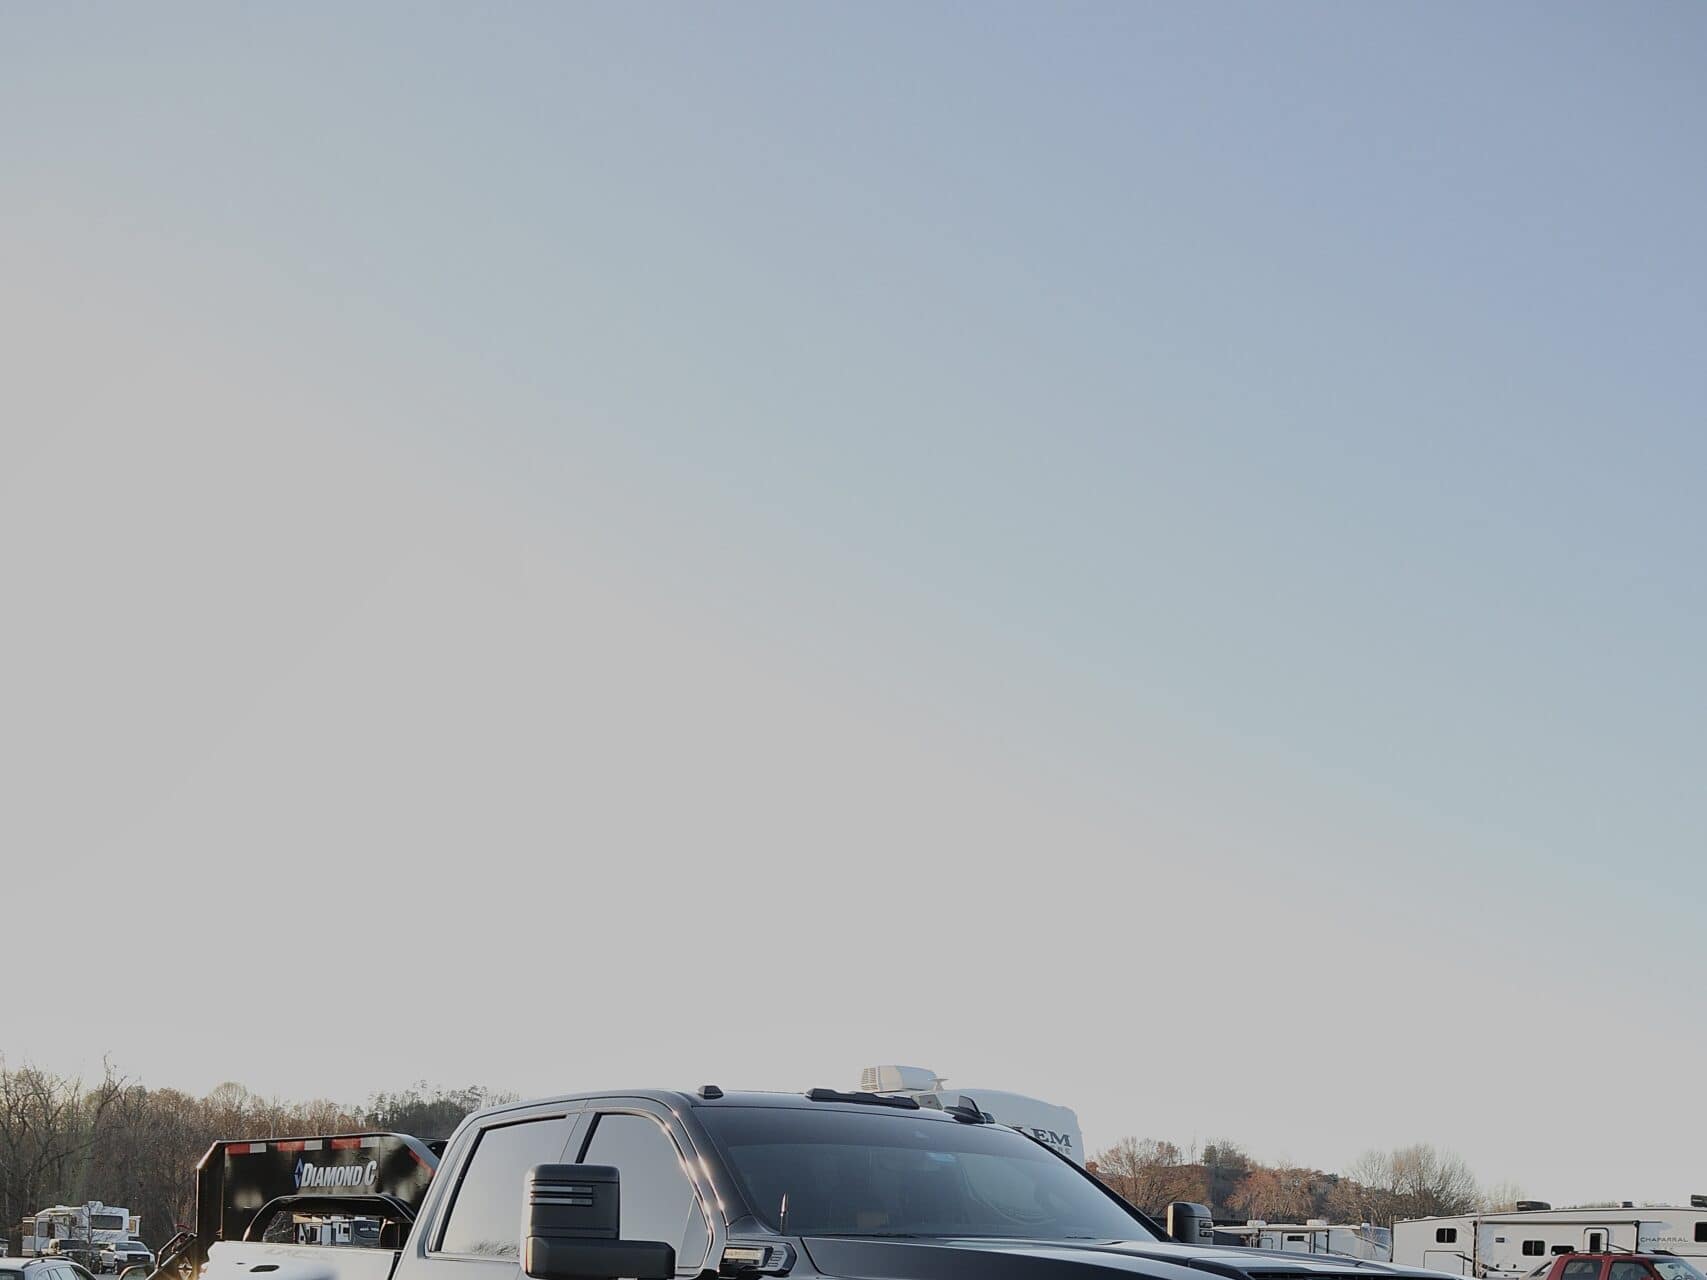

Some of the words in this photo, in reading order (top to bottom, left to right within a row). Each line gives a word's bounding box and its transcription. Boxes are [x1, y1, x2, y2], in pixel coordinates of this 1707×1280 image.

[1014, 1127, 1073, 1148] EM
[301, 1163, 363, 1187] DIAMOND
[363, 1160, 377, 1186] C
